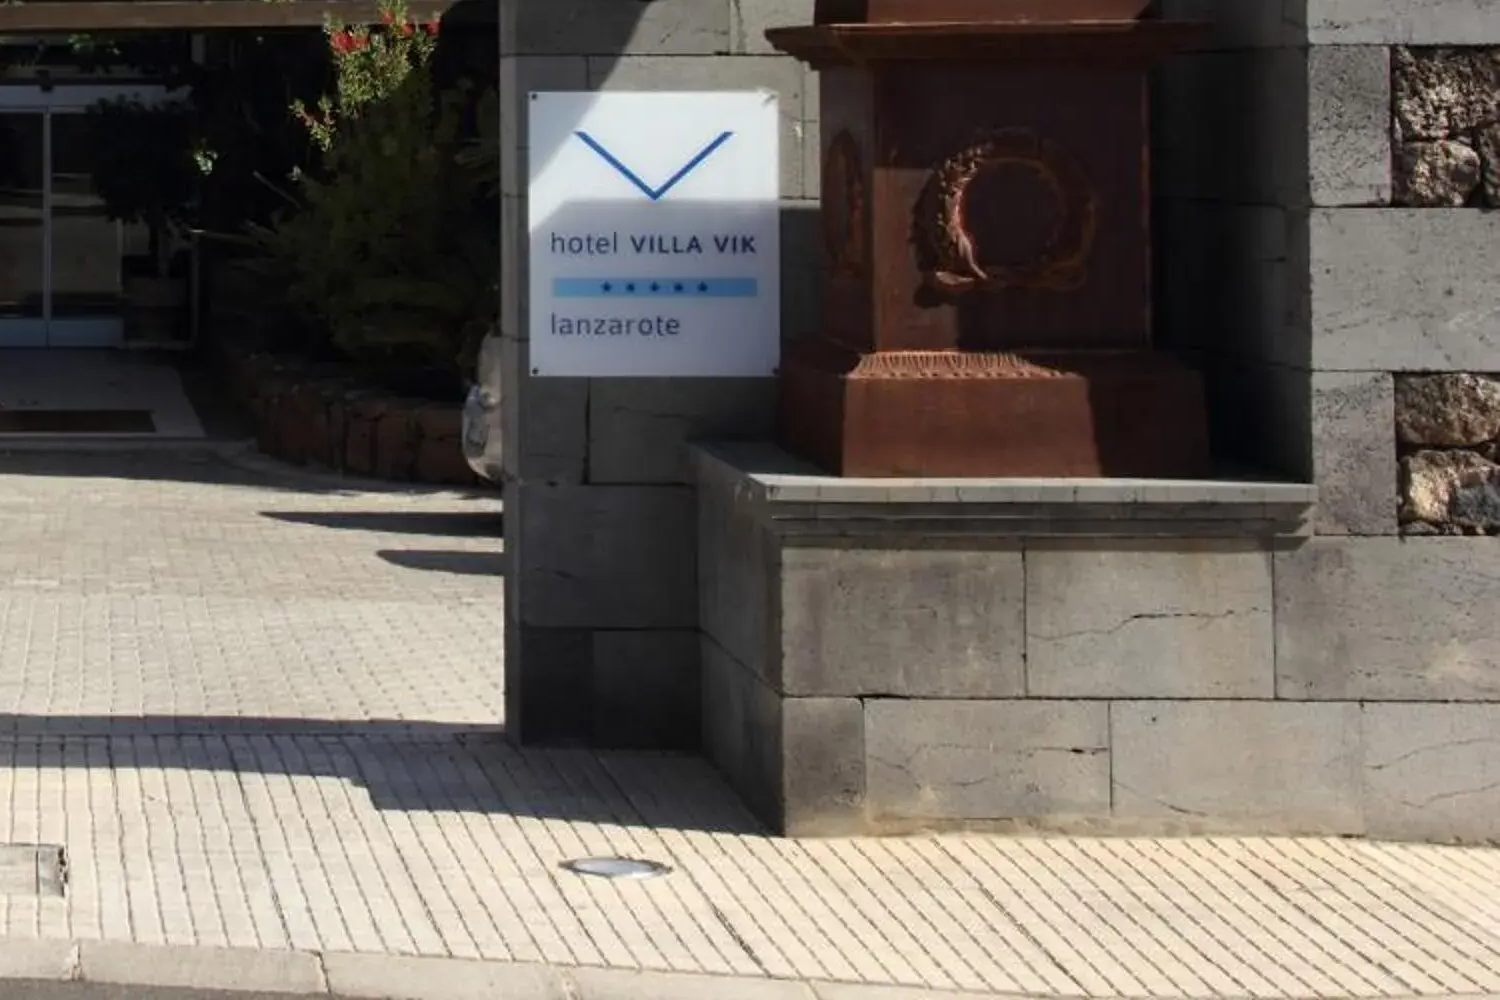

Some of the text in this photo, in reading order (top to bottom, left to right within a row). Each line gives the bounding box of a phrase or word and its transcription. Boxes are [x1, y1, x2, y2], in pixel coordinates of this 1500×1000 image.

[550, 232, 757, 254] hotel VILLA VIK
[550, 312, 681, 336] lanzarote
